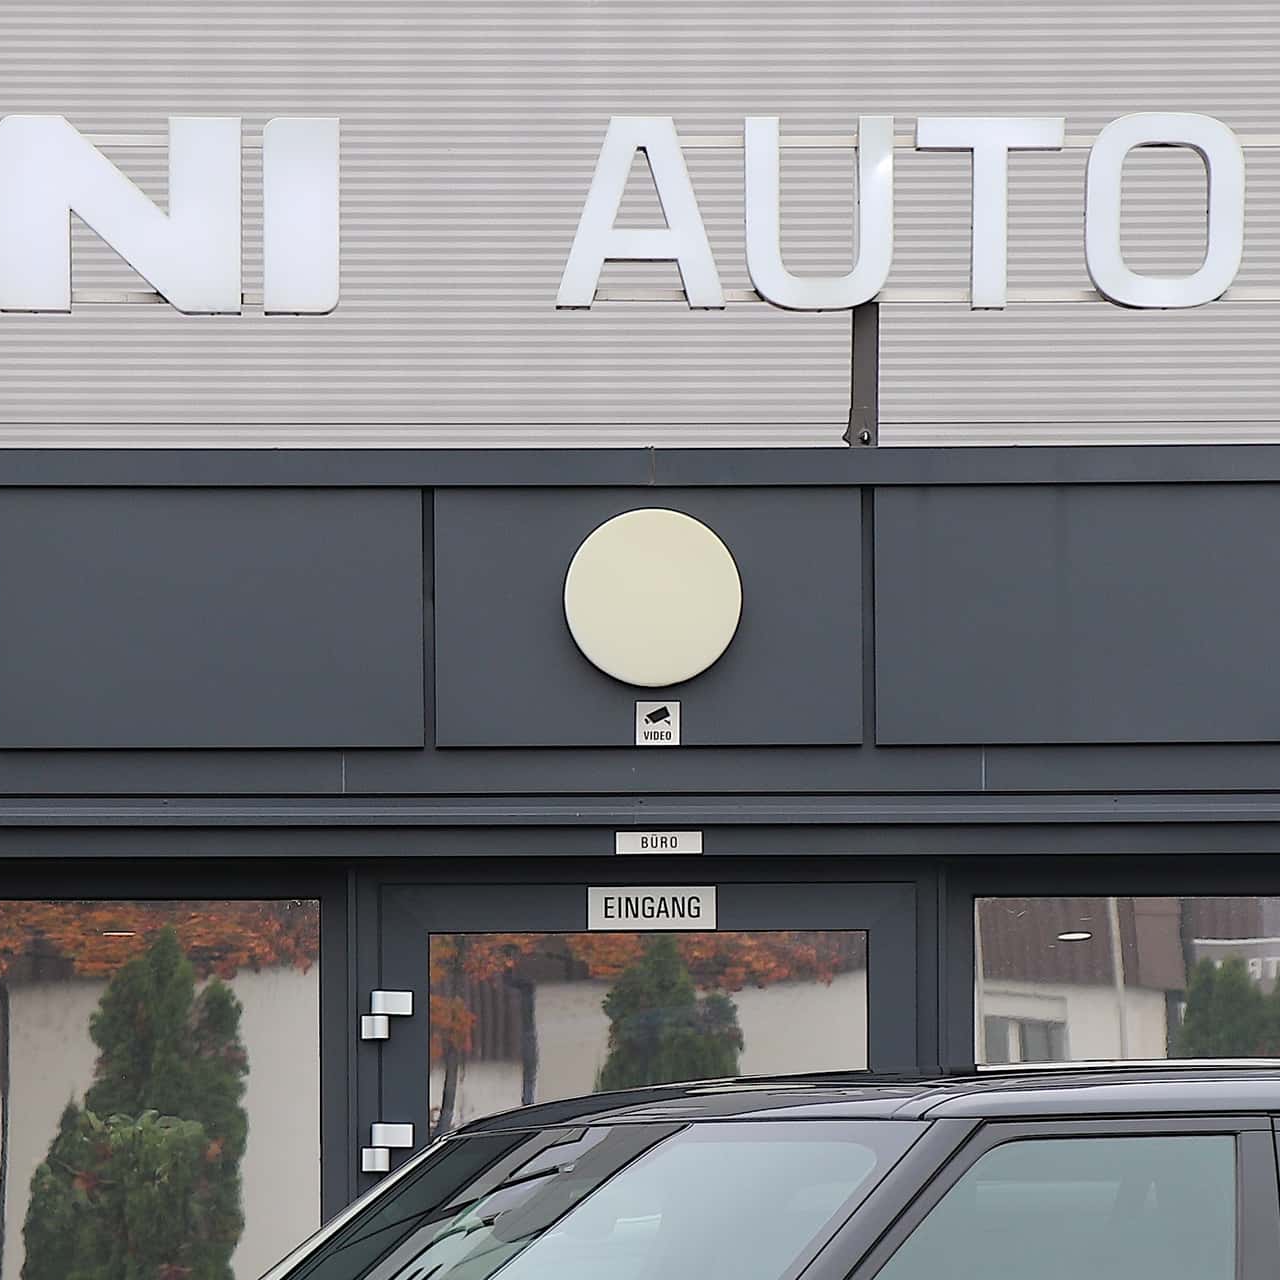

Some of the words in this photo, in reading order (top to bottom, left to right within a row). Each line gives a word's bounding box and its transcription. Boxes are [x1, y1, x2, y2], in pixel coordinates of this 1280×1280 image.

[556, 111, 1245, 312] AUTO
[643, 731, 672, 741] VIDEO
[640, 834, 678, 849] BÜRO
[603, 896, 702, 919] EINGANG
